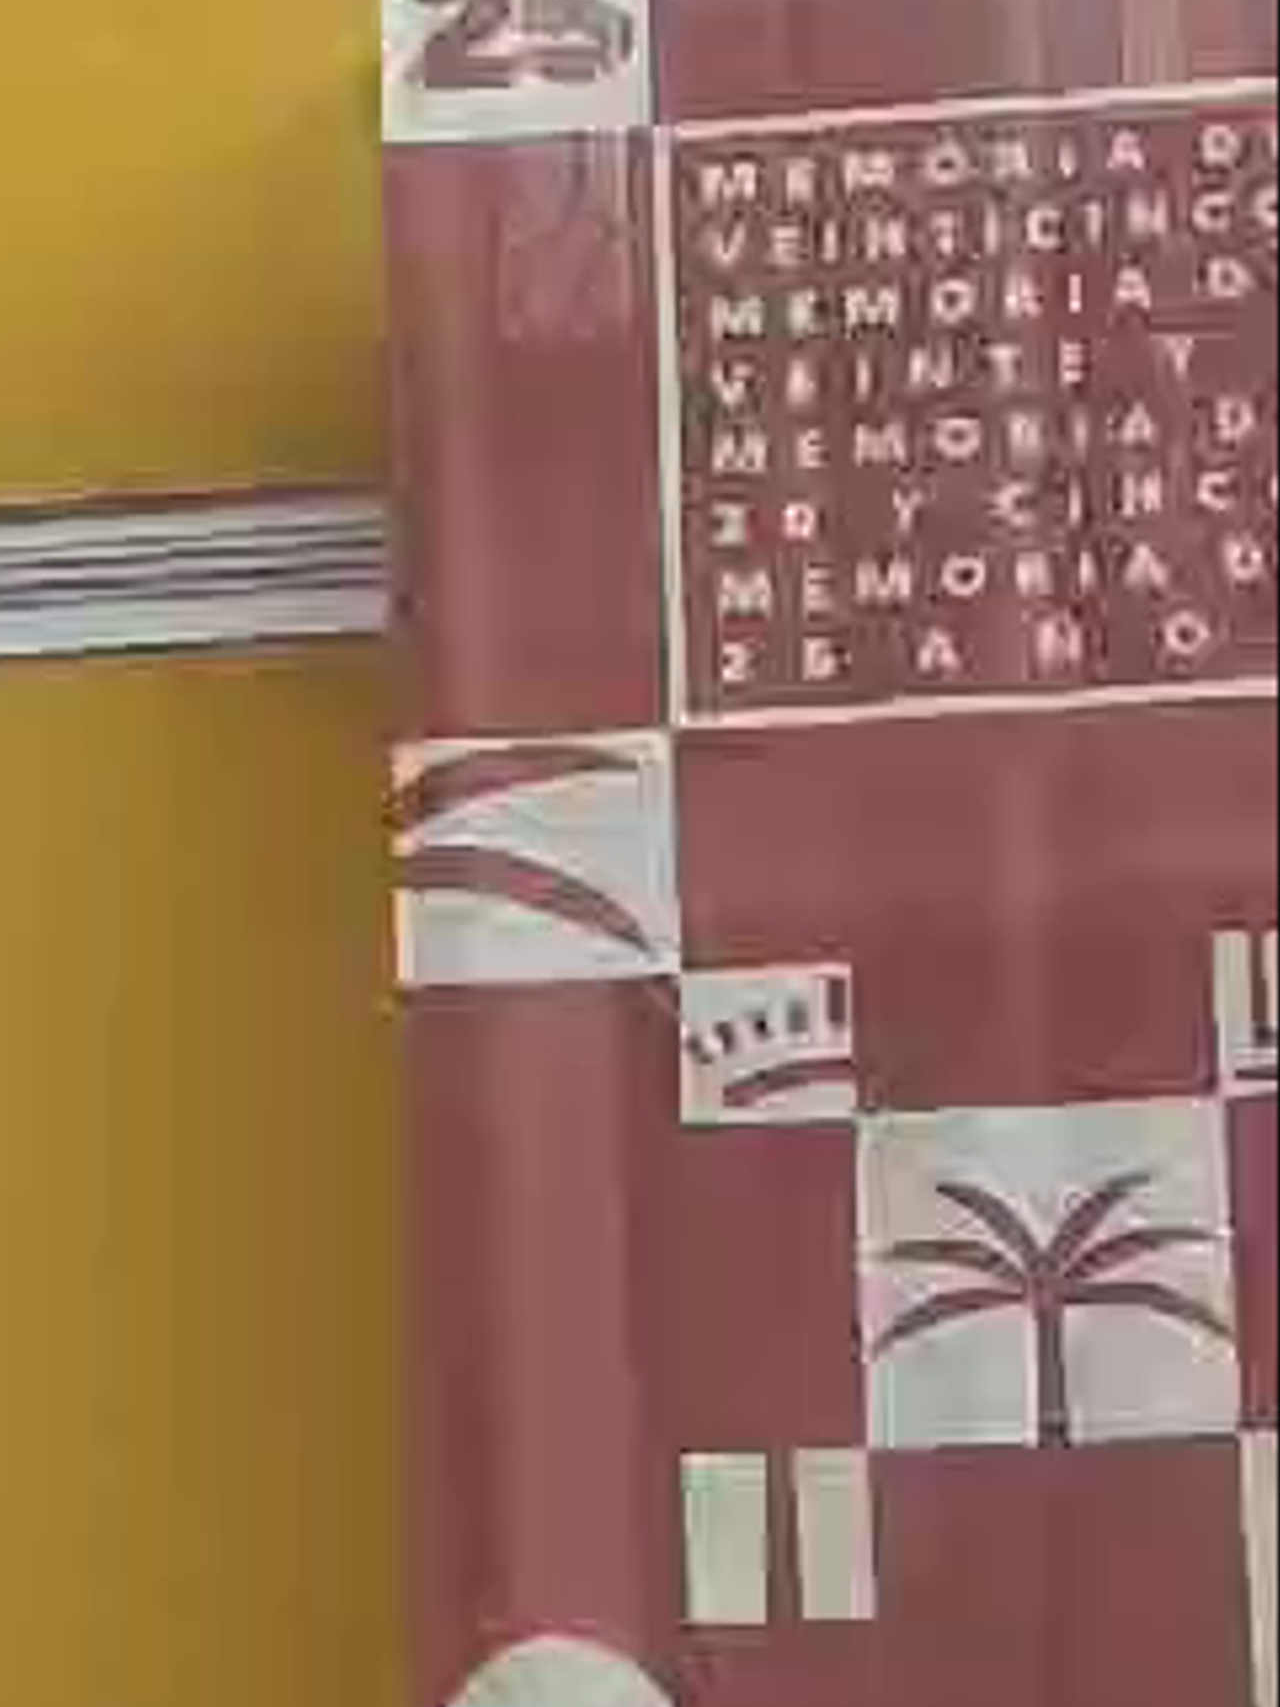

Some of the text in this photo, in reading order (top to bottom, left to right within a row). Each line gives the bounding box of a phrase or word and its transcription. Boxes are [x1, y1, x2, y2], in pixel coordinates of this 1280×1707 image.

[699, 129, 1144, 200] MEMORIA
[710, 266, 1151, 336] MEMORIA
[711, 334, 1195, 404] VEINTE Y
[711, 401, 1156, 473] MEMORIA
[891, 488, 923, 533] Y
[718, 545, 1169, 616] MEMORIA
[721, 637, 838, 682] 25
